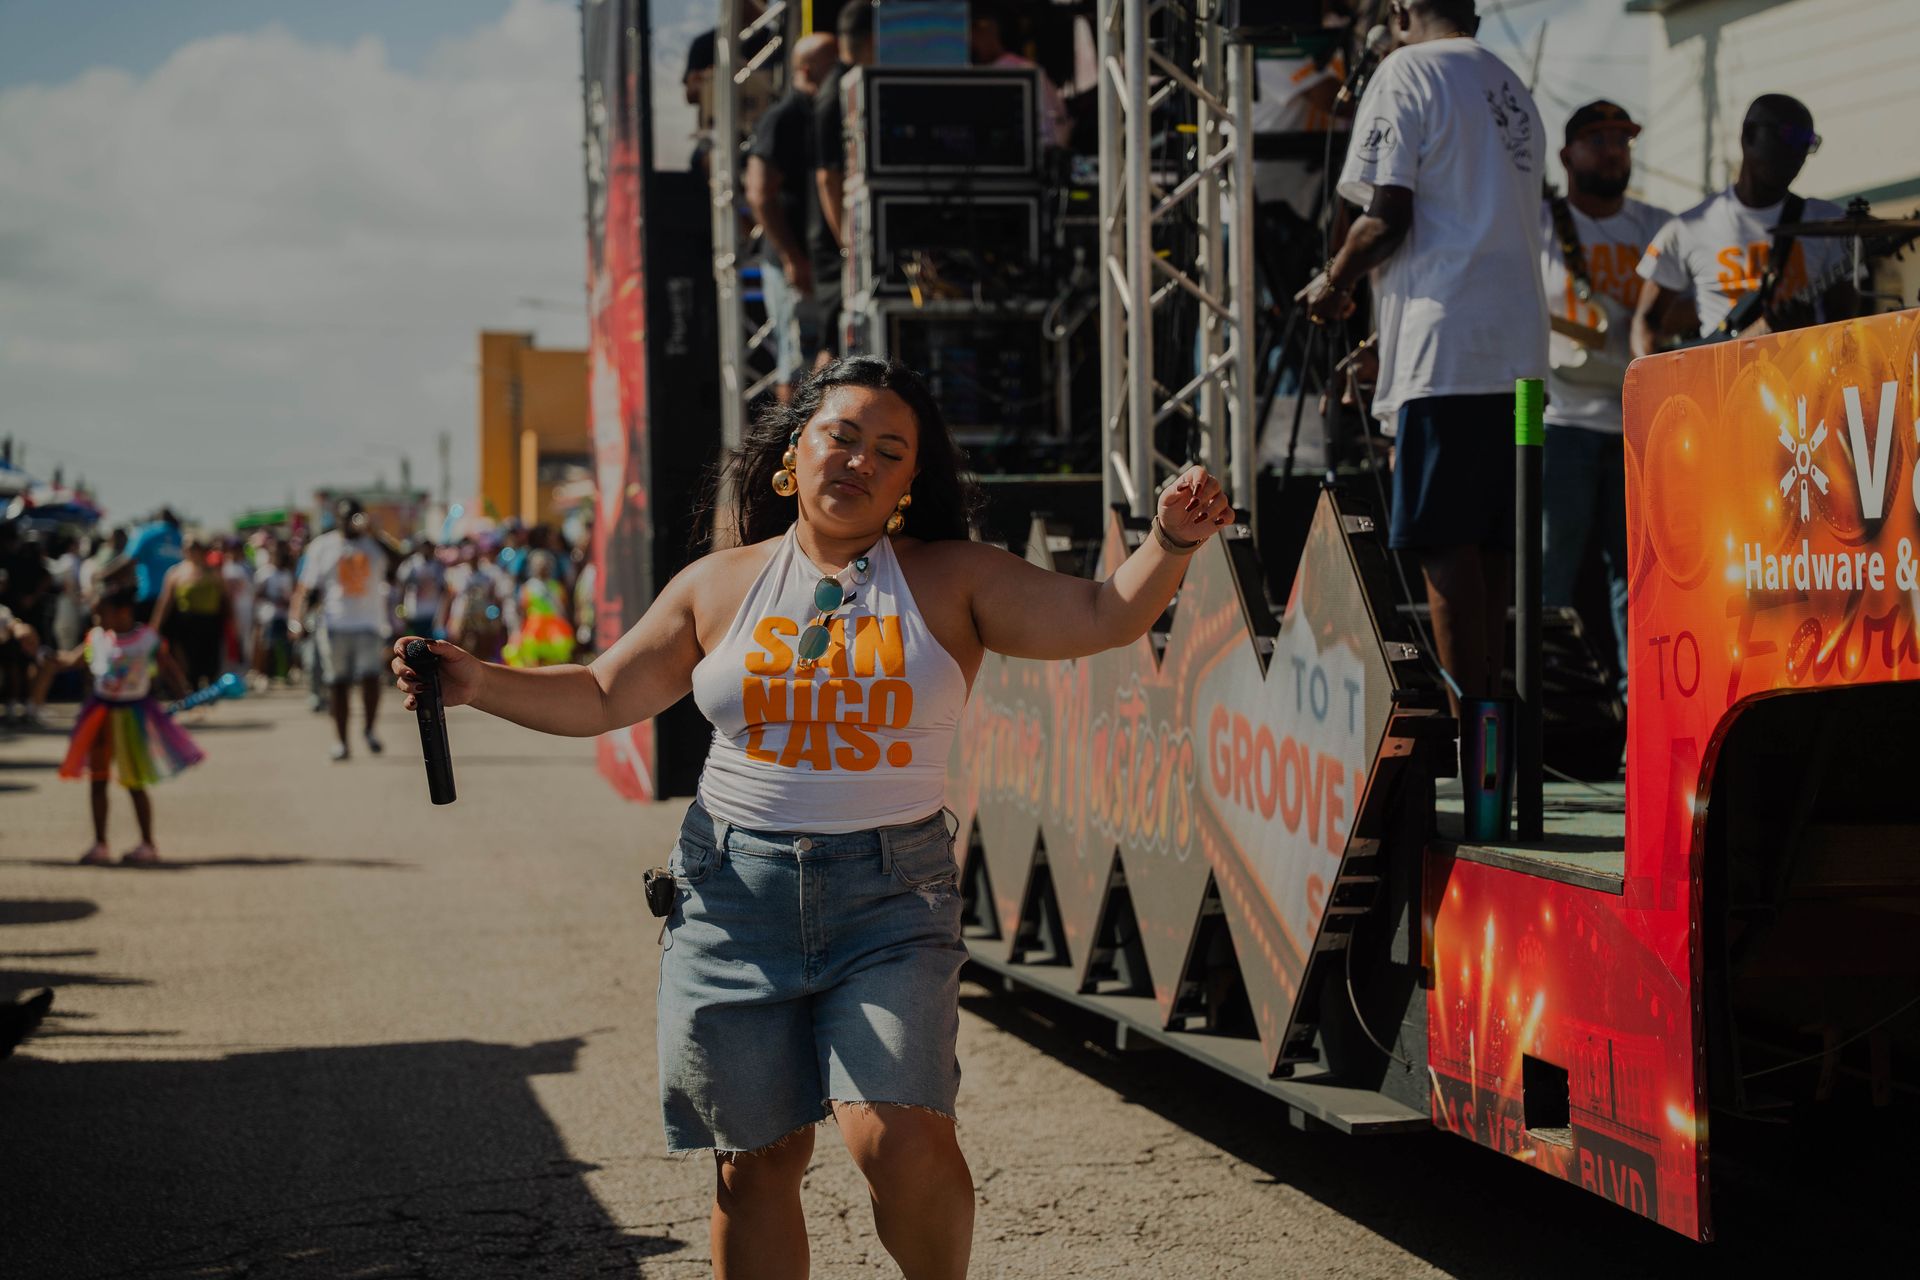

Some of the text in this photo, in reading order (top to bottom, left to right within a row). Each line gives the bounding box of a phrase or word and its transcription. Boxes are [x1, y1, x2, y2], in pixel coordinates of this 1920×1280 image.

[1580, 243, 1642, 279] AN
[1843, 381, 1920, 519] V
[1744, 537, 1918, 591] Hardware &
[744, 615, 906, 678] SAN
[1648, 630, 1700, 700] TO
[742, 676, 913, 729] NICO
[1290, 653, 1329, 723] TO
[1208, 703, 1346, 858] GROOVE
[1579, 1146, 1648, 1217] BLVD
